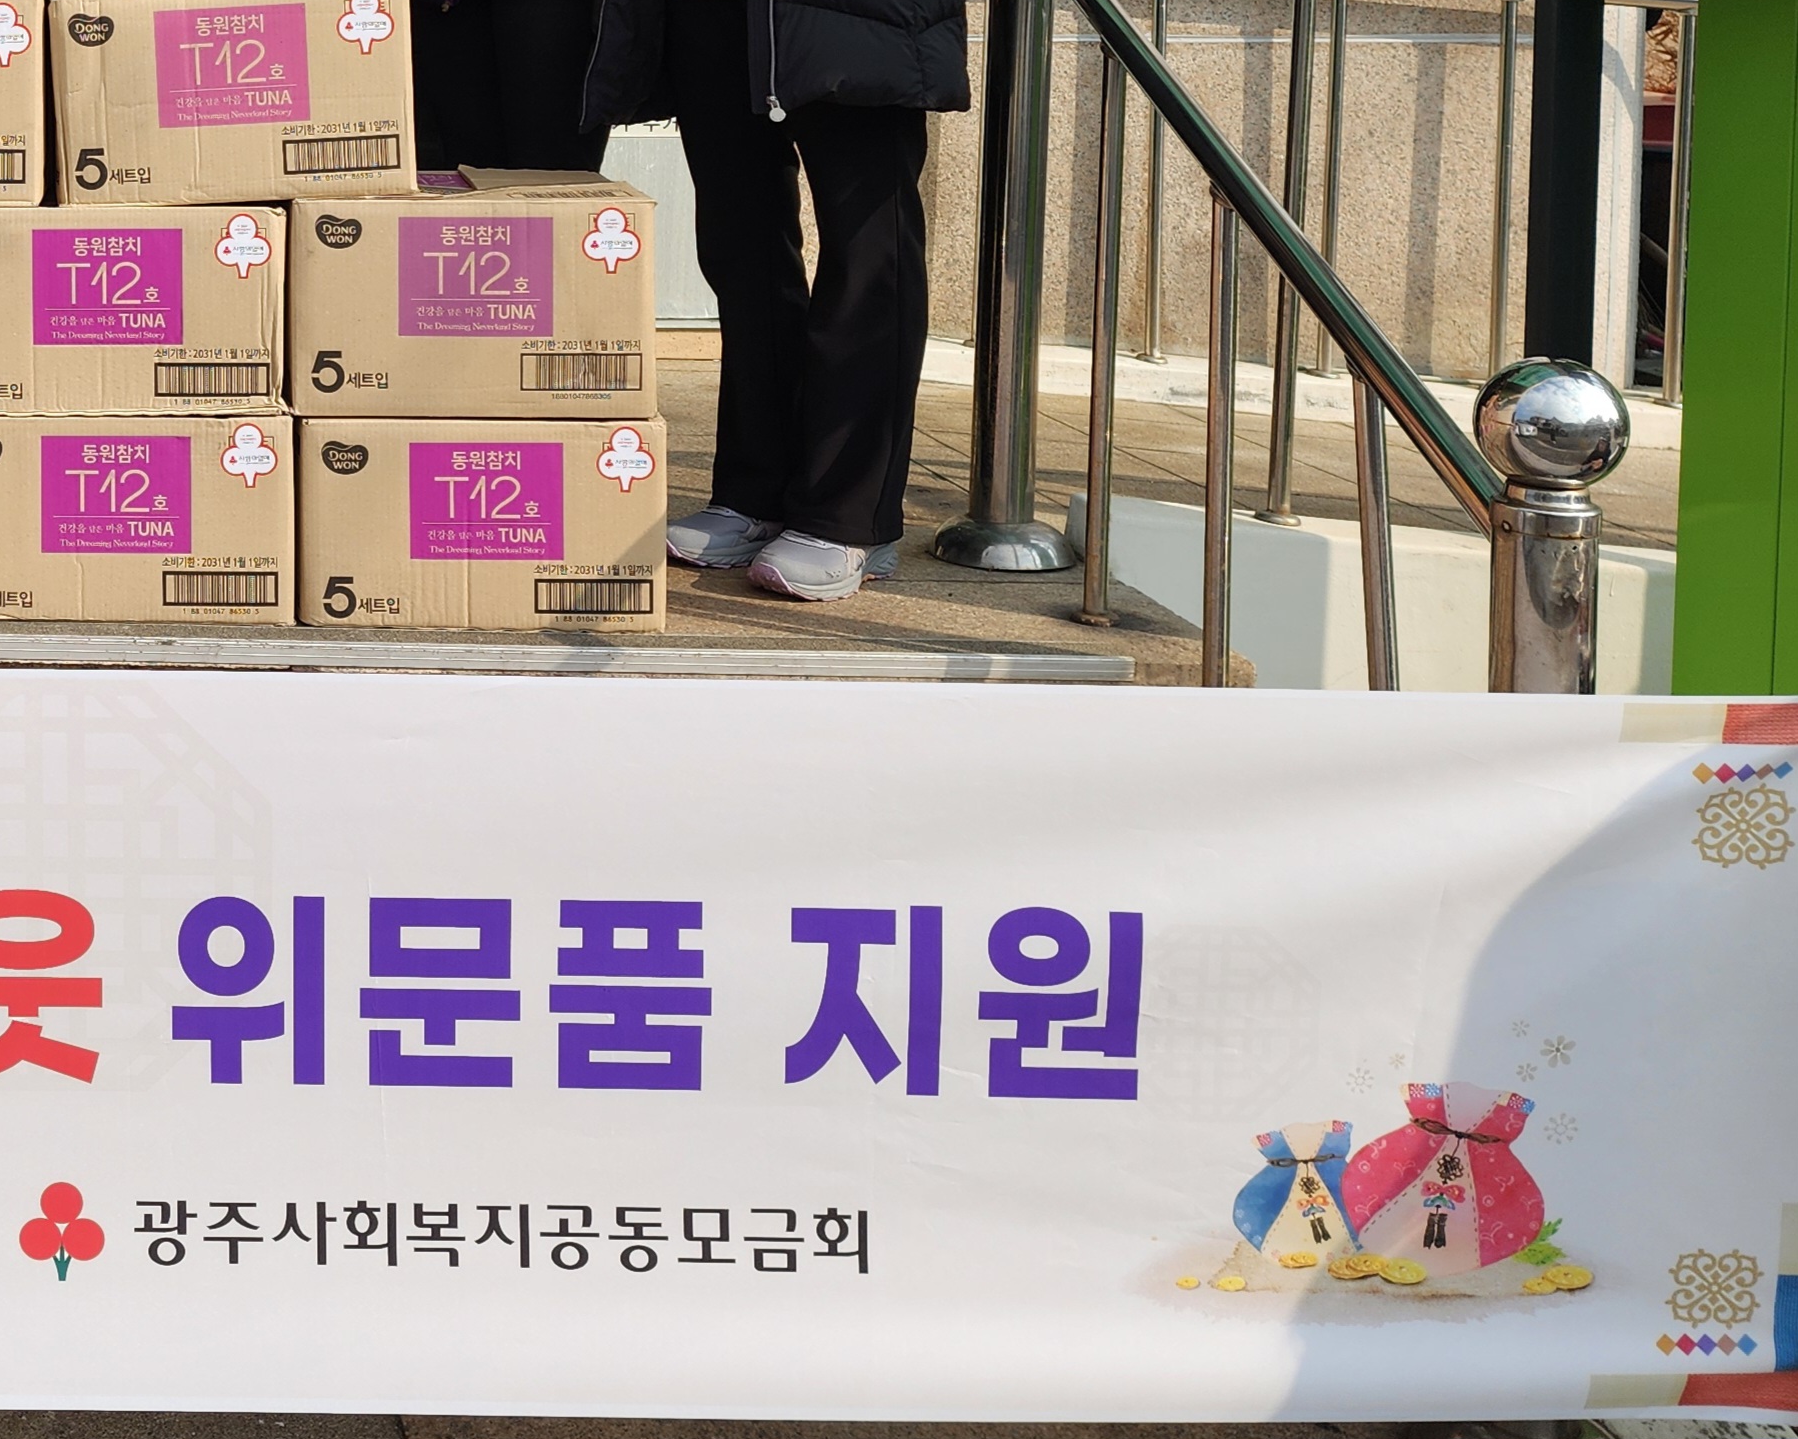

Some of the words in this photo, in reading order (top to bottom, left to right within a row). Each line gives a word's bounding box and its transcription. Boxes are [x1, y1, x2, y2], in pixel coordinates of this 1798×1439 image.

[195, 15, 264, 36] 동원참치
[244, 90, 294, 108] TUNA
[439, 224, 510, 247] 동원참치
[72, 236, 142, 258] 동원참치
[119, 313, 166, 328] TUNA
[487, 302, 536, 320] TUNA
[81, 442, 151, 464] 동원참치
[451, 450, 522, 471] 동원참치
[127, 522, 174, 537] TUNA
[498, 528, 547, 545] TUNA
[171, 895, 713, 1093] 위문품
[784, 904, 1144, 1101] 지원
[133, 1199, 876, 1277] 광주사회복지공동모금회
